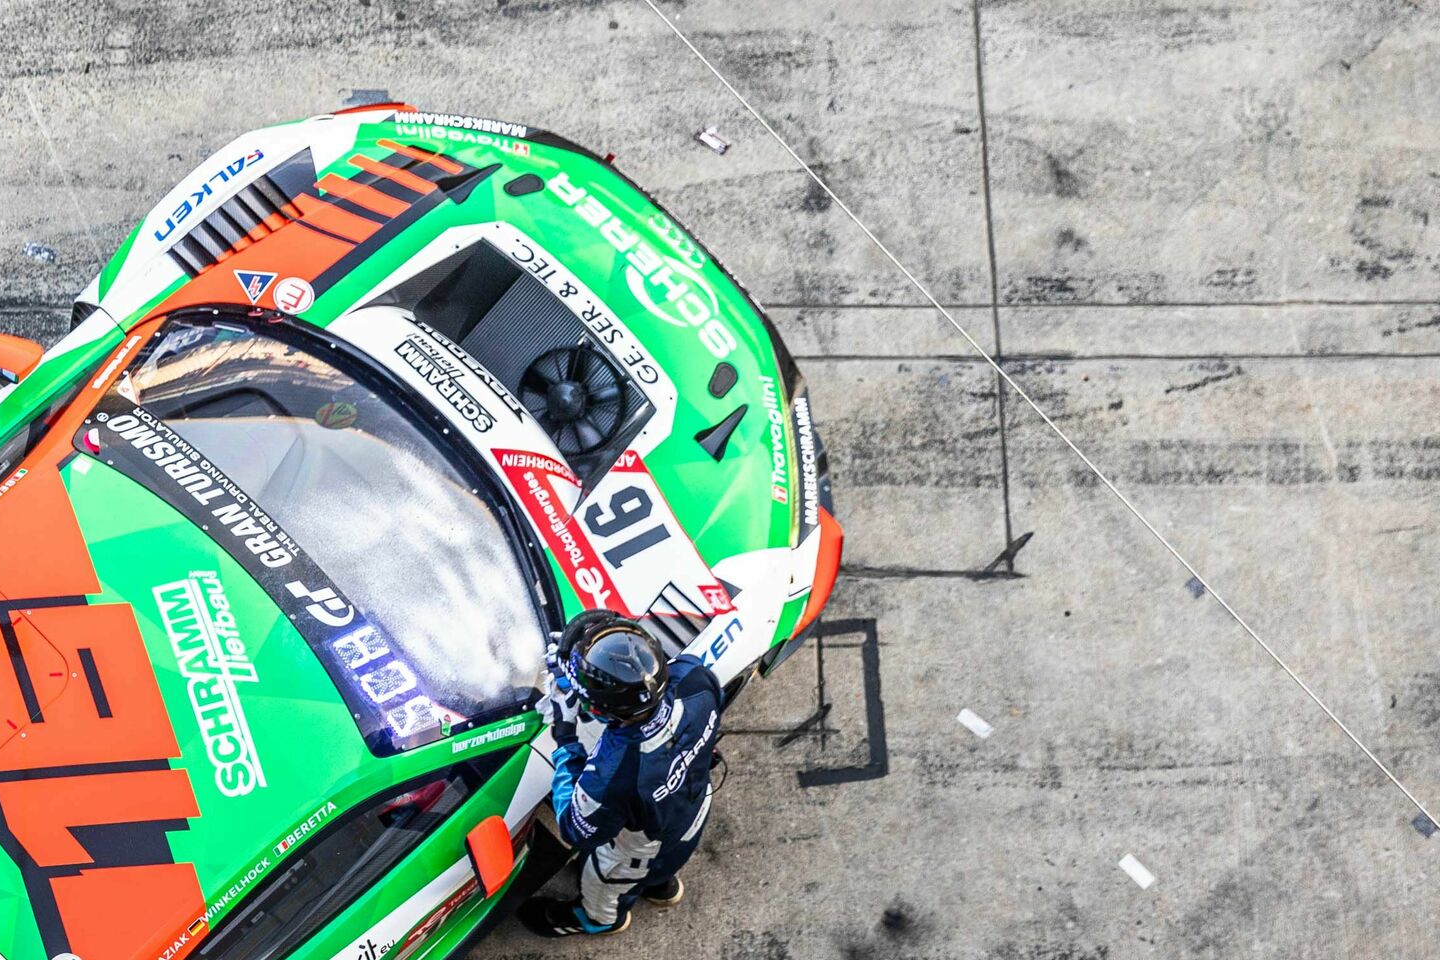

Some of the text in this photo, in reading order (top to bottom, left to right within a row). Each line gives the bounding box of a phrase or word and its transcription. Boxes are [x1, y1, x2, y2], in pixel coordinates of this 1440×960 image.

[394, 111, 528, 138] MAREKSCHRAMM
[154, 149, 265, 242] FALKEN
[546, 171, 739, 359] SCHERER
[394, 340, 495, 434] SCHRAMM
[770, 376, 790, 484] Travaglini
[106, 413, 294, 569] GRAN TURISMO
[132, 408, 302, 557] THE REAL DRIVING SIMULATOR
[790, 396, 819, 526] MAREKSCHRAMM
[523, 470, 586, 569] TotalEnergies
[583, 485, 672, 571] 16
[203, 577, 260, 684] Tiefbau
[151, 578, 258, 798] SCHRAMM
[651, 709, 719, 803] SCHERER
[286, 800, 338, 848] BERETTA
[199, 856, 272, 924] WINKELHOCK
